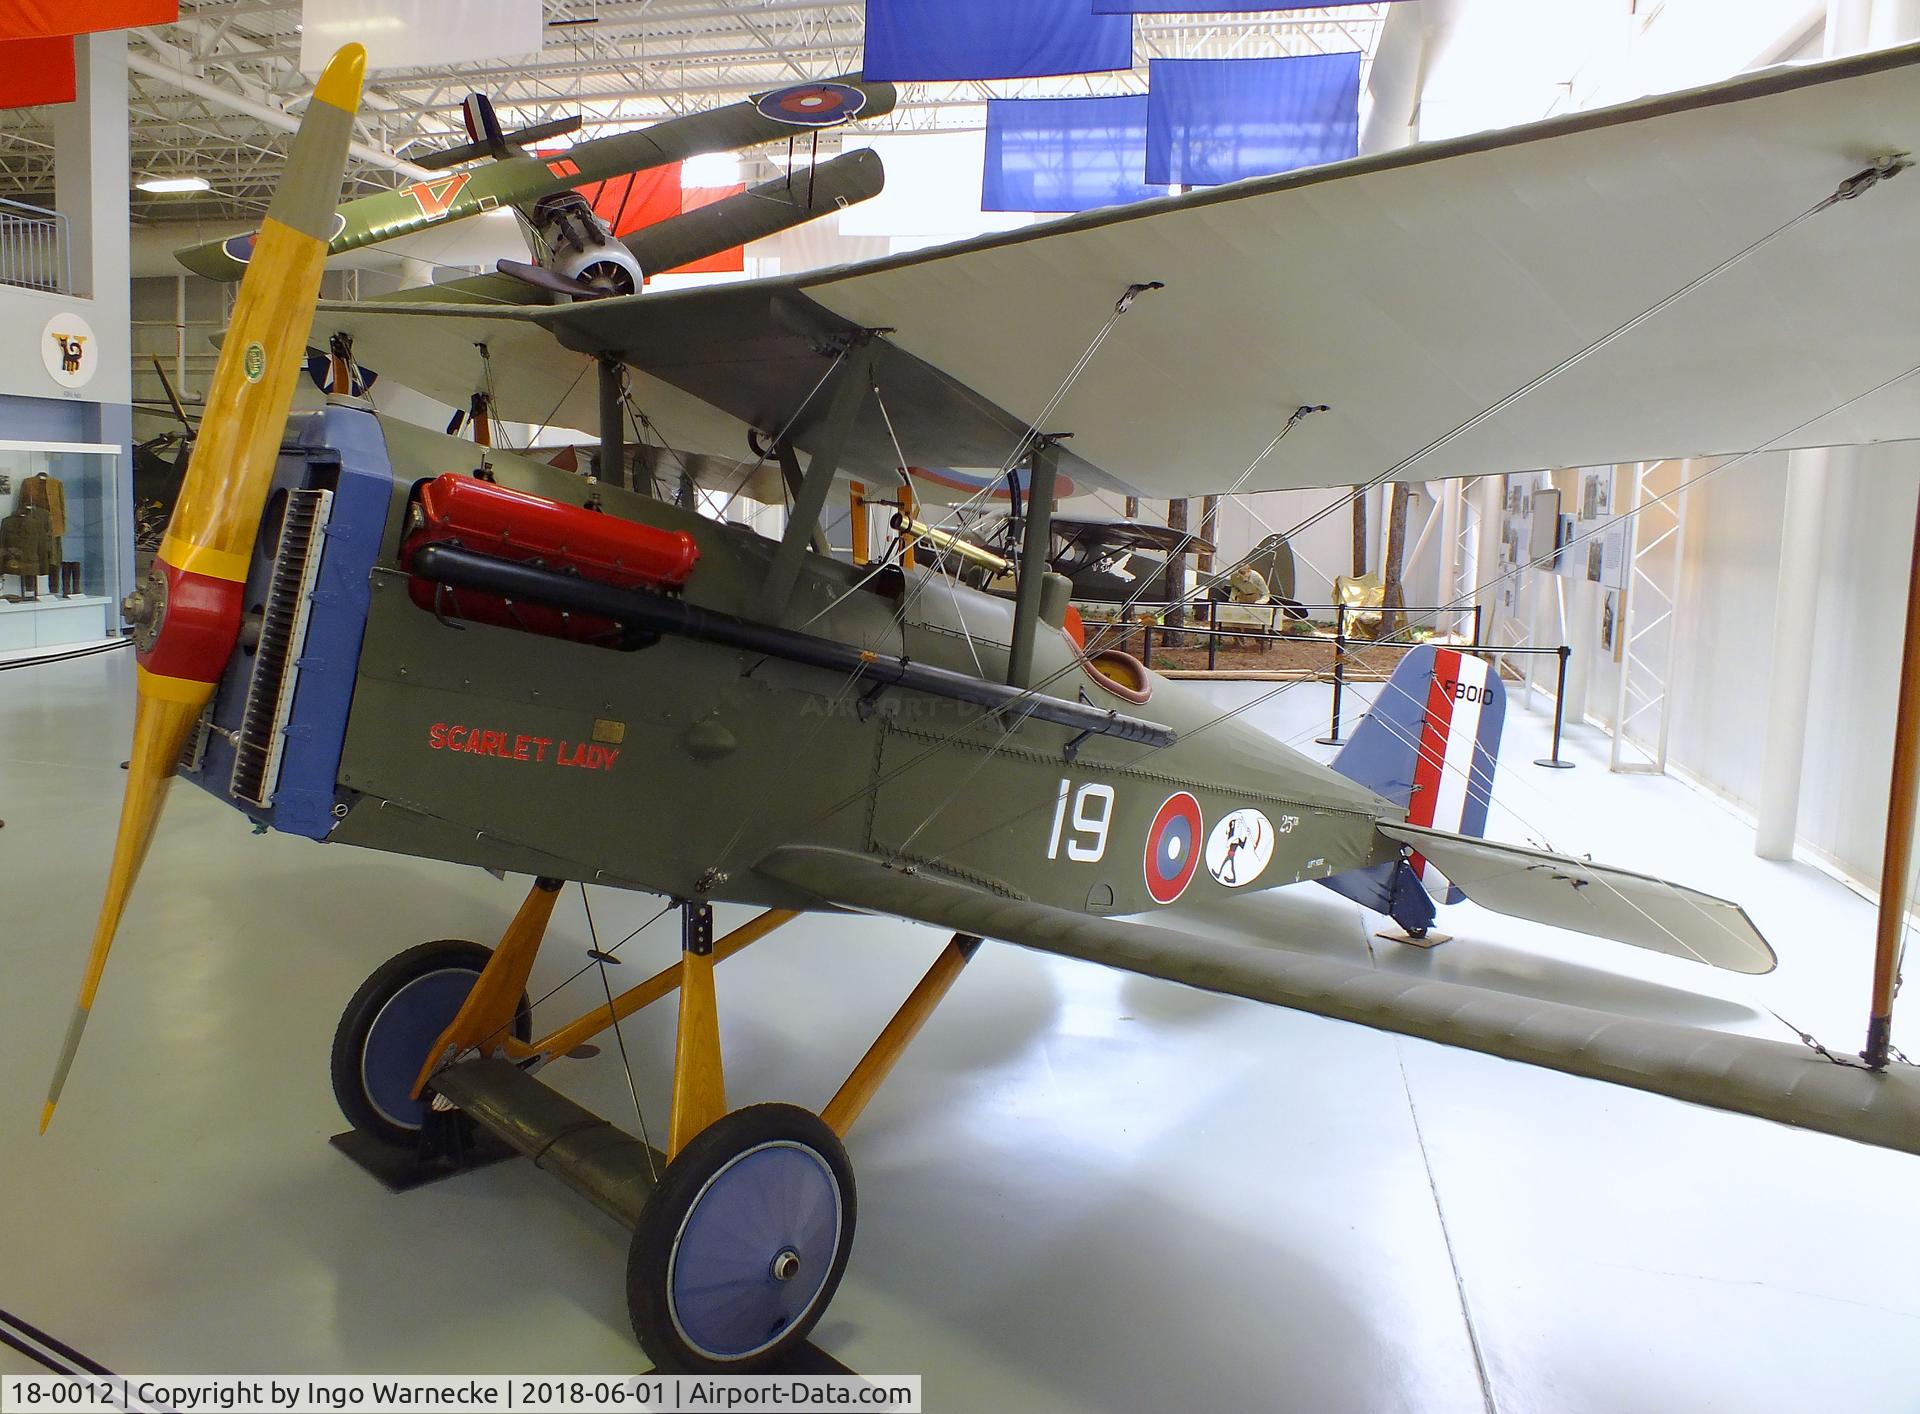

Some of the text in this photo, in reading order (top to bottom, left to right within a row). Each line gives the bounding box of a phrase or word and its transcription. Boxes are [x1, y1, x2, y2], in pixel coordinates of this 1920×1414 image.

[1444, 679, 1494, 706] F8010
[429, 723, 552, 762] SCARLET
[557, 740, 620, 771] LADY
[1047, 778, 1115, 862] 19
